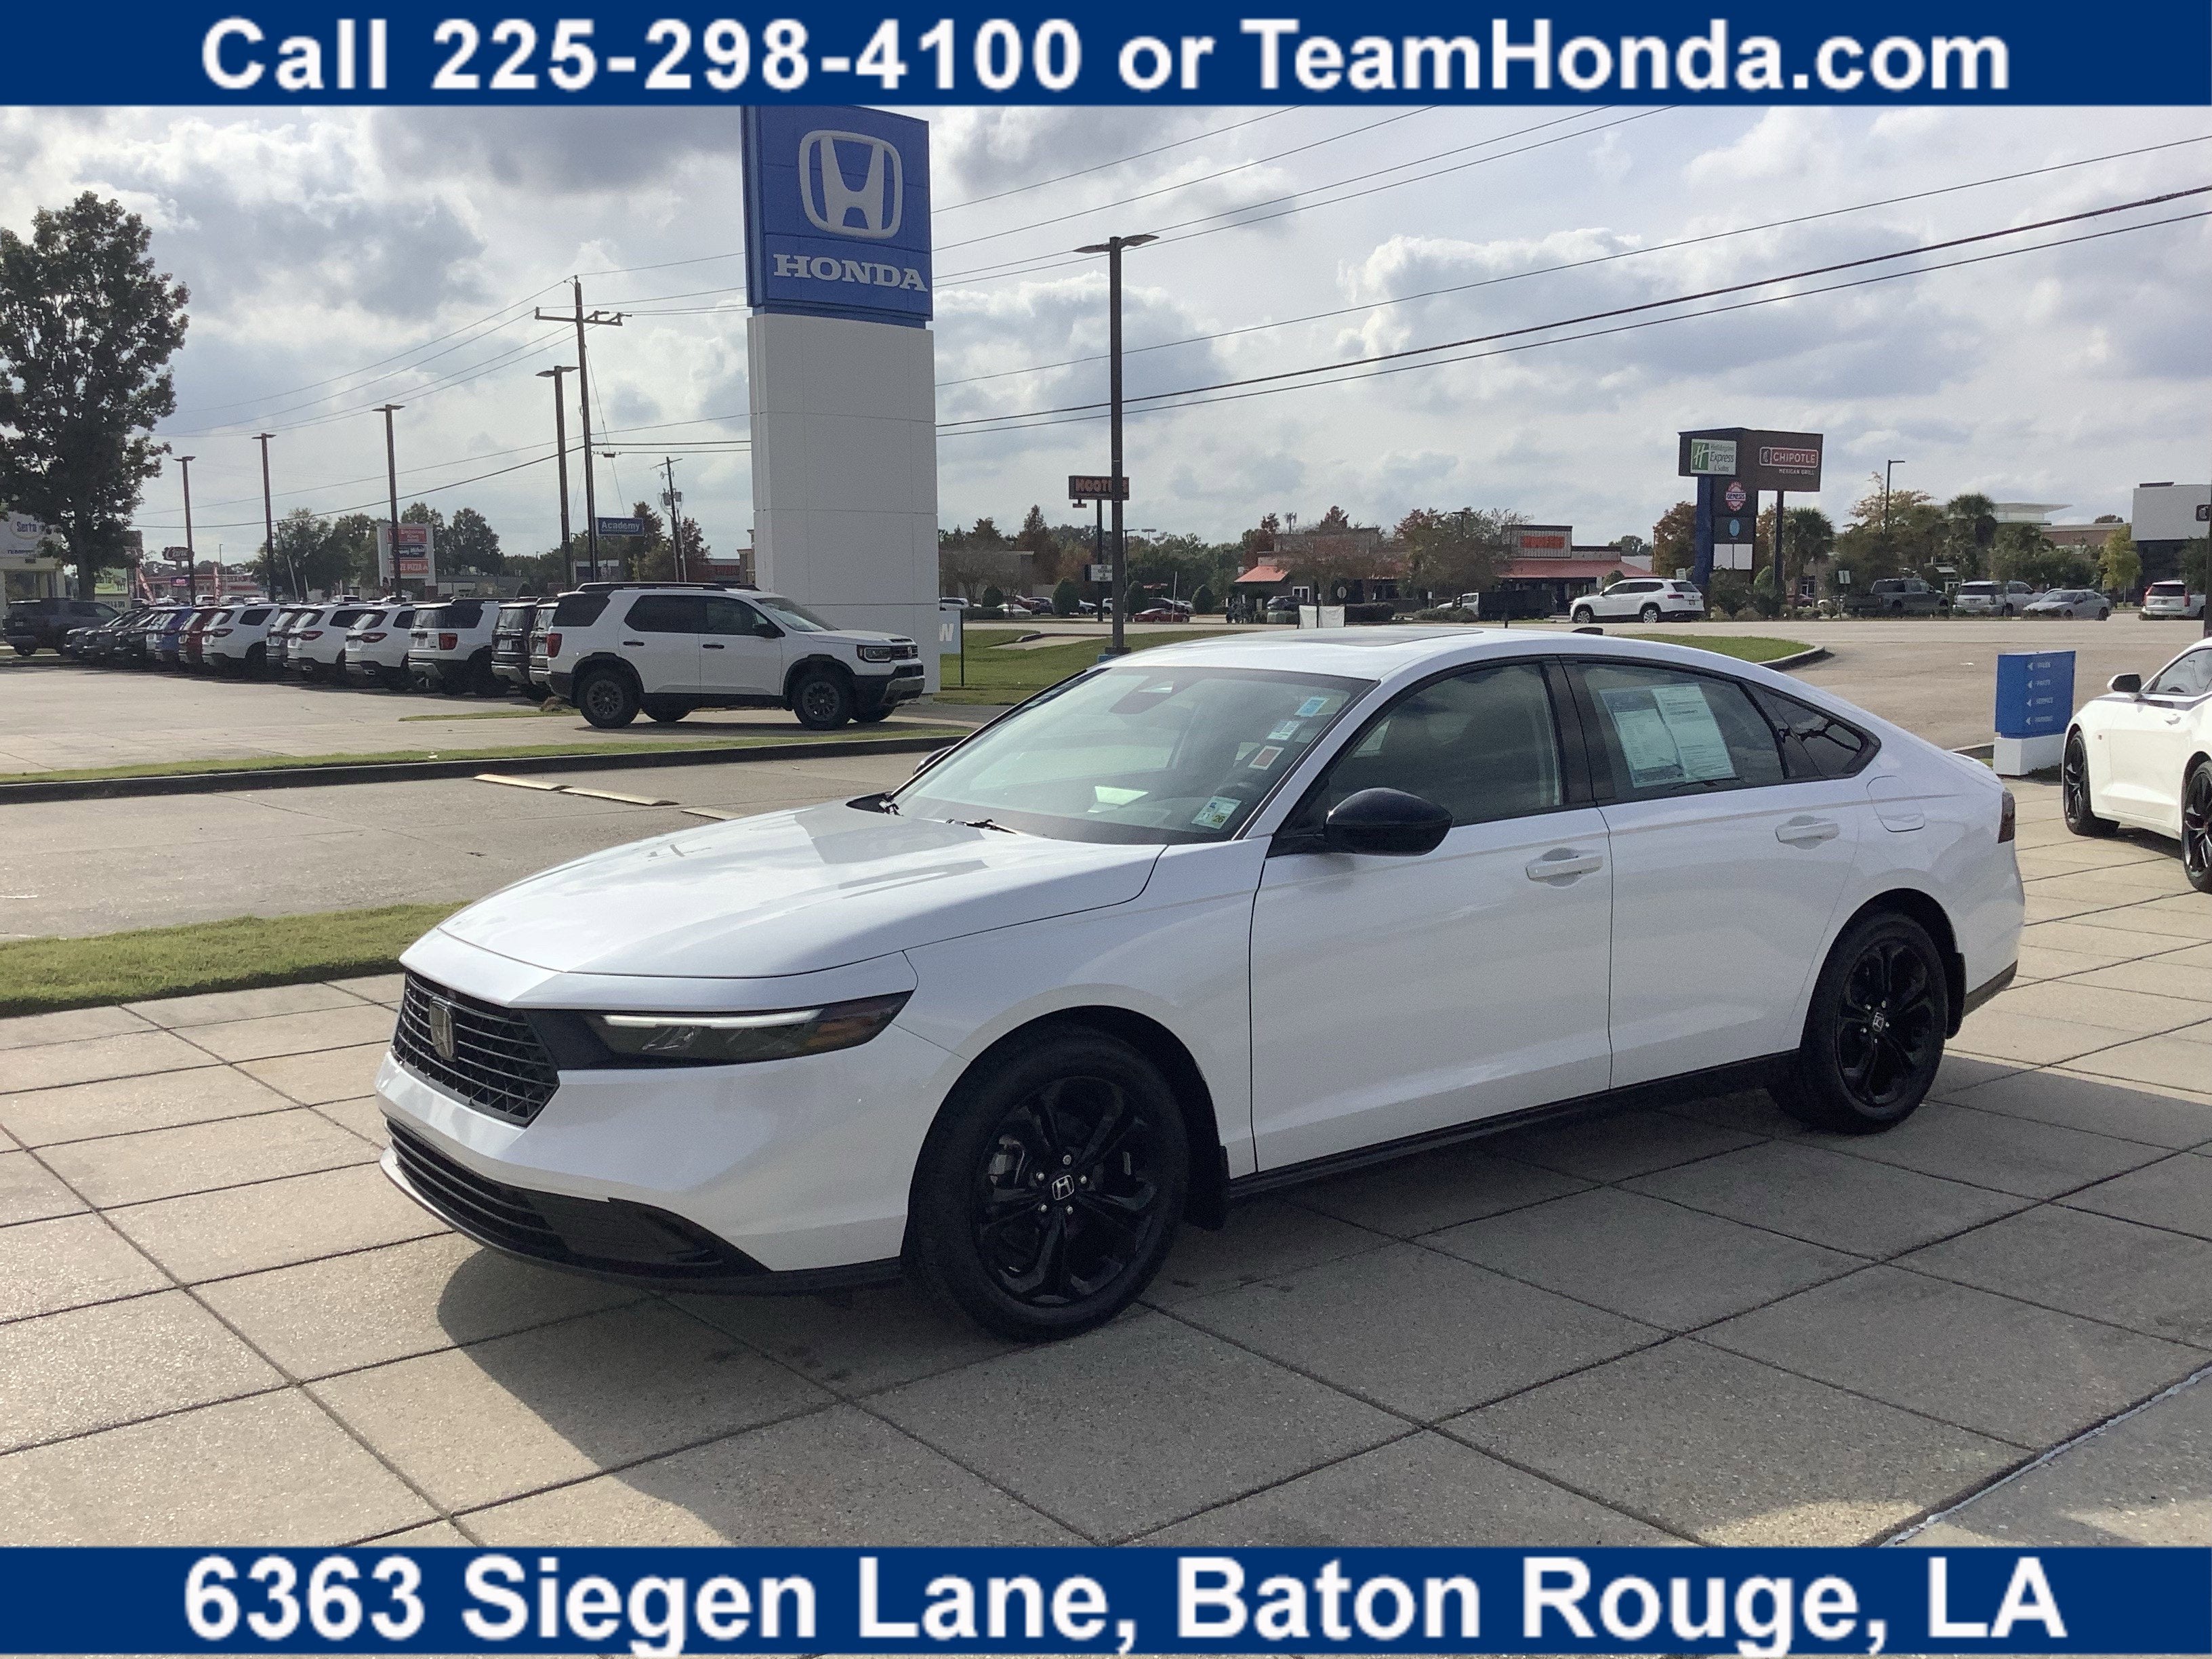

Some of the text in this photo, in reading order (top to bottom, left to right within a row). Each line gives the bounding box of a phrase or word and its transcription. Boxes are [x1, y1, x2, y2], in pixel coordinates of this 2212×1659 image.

[773, 253, 928, 292] HONDA
[1710, 451, 1734, 464] Express
[1773, 451, 1816, 464] CHIPOTLE
[1076, 478, 1128, 493] HOOTS
[17, 521, 37, 532] Serta
[601, 521, 640, 532] Academy
